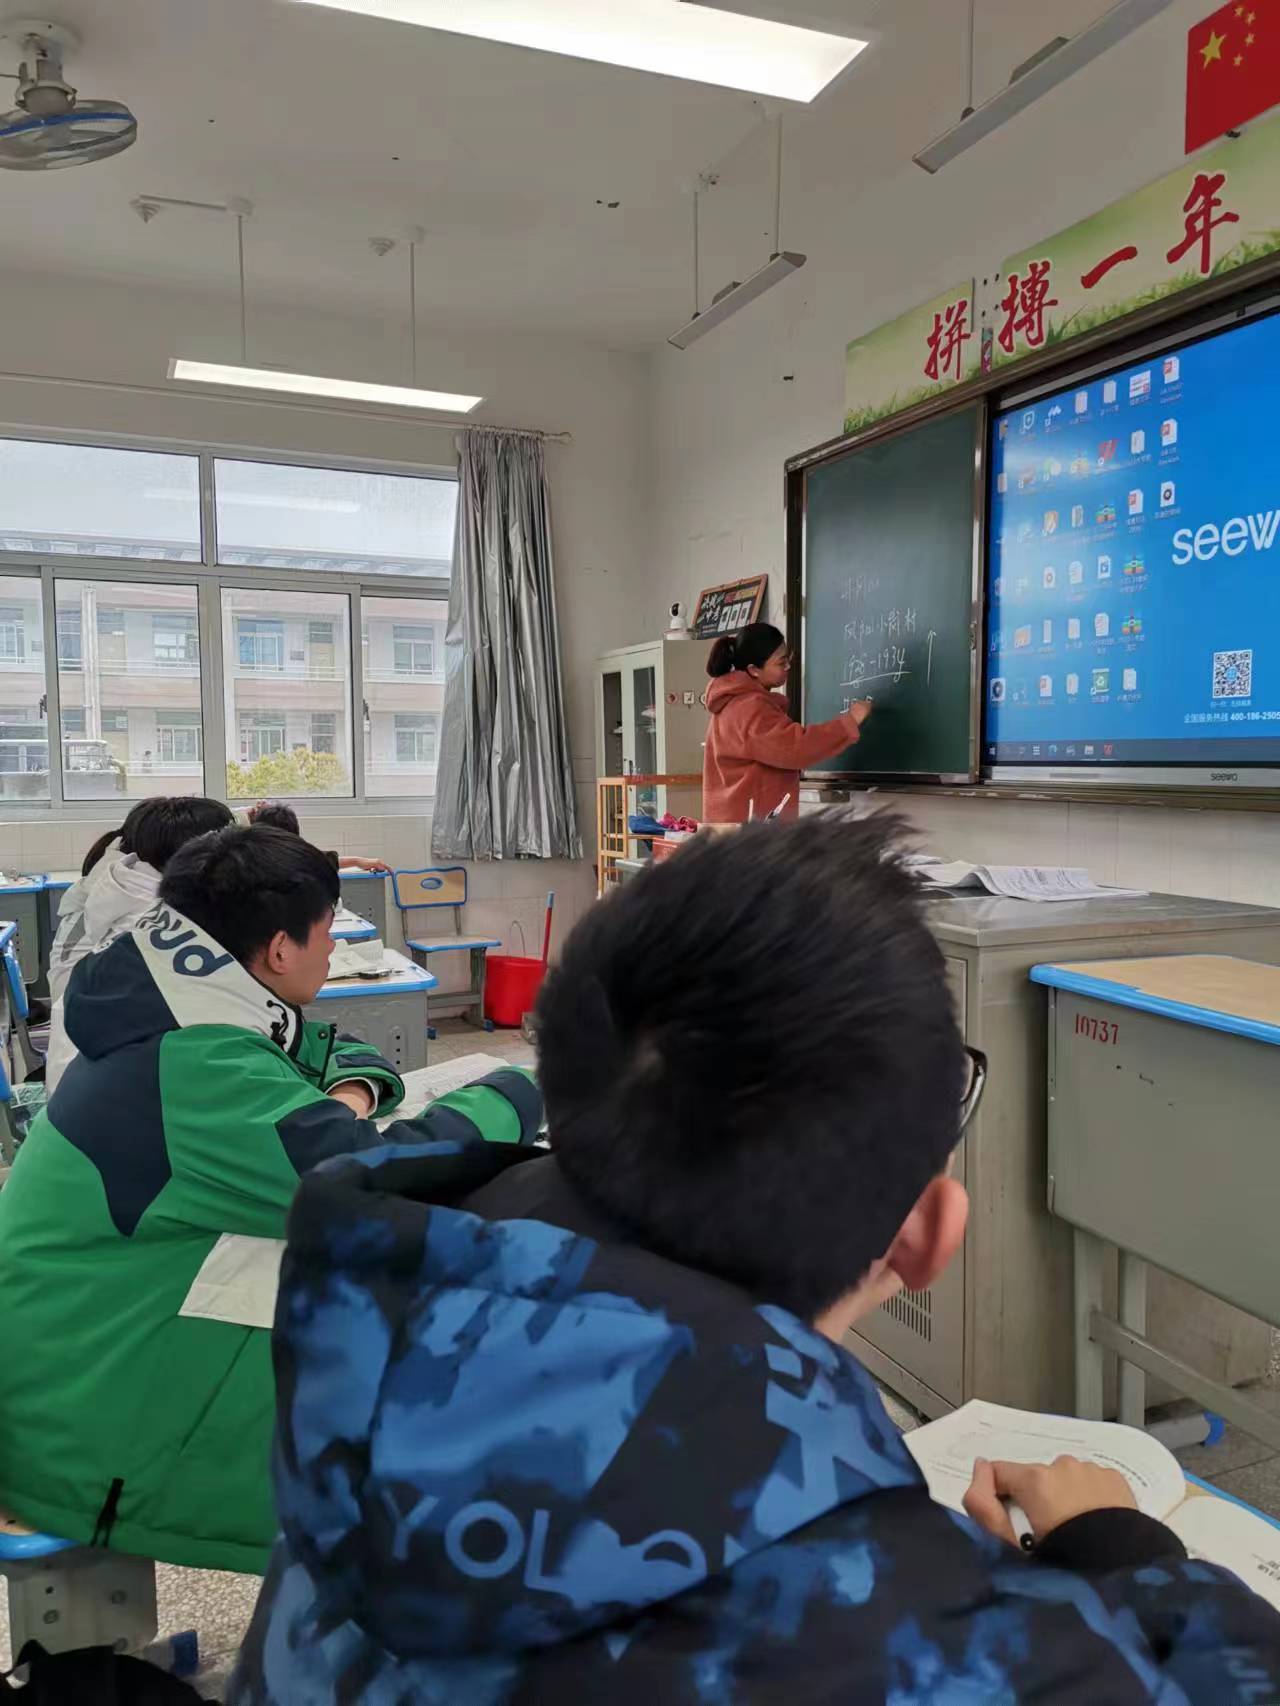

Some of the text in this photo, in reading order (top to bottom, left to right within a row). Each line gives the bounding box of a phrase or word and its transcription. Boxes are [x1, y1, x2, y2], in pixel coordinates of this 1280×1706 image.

[924, 174, 1239, 380] 拼搏一年
[1075, 1013, 1118, 1045] 10737
